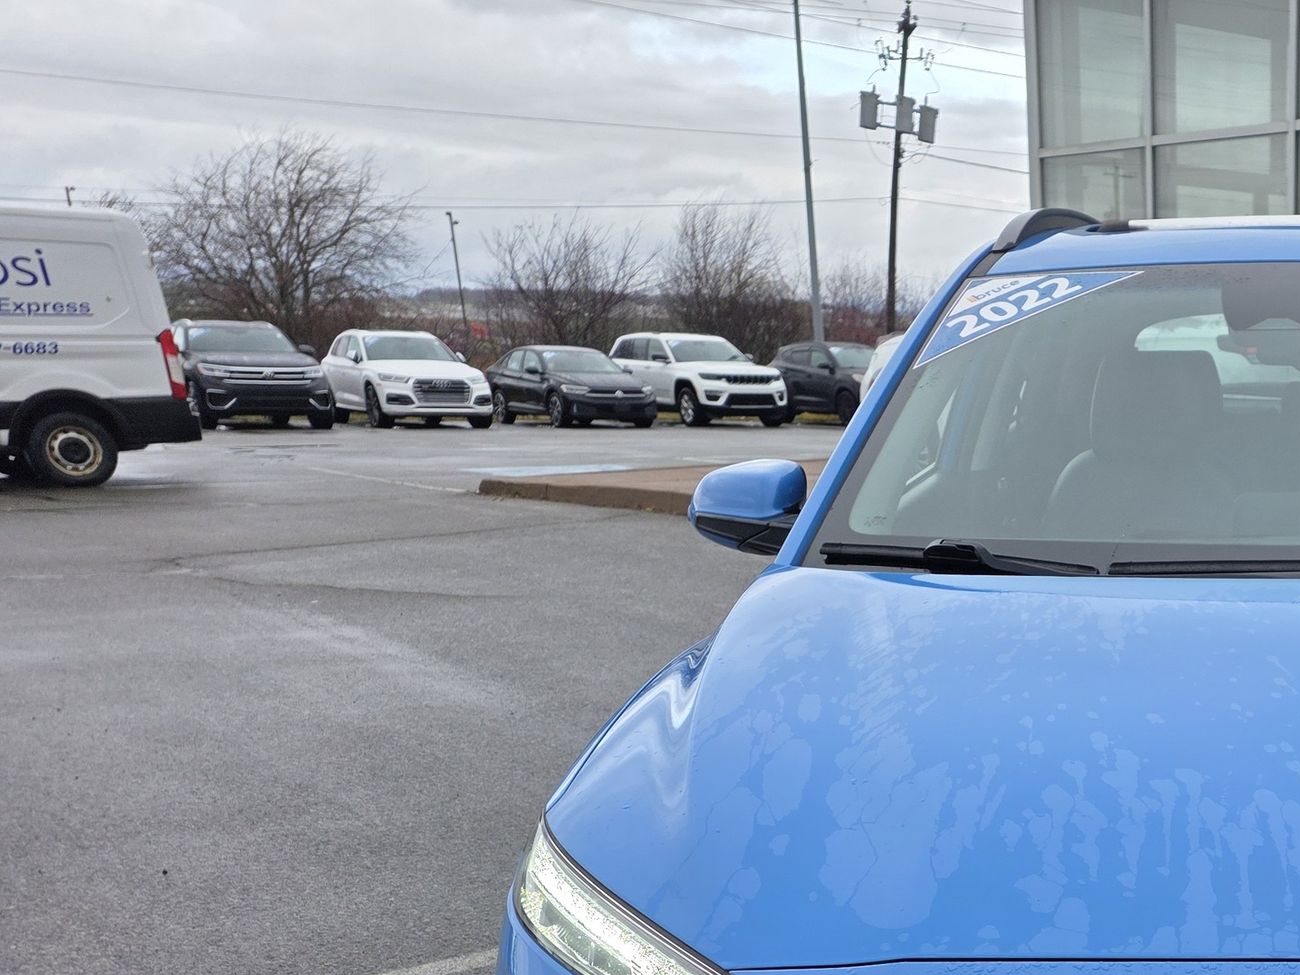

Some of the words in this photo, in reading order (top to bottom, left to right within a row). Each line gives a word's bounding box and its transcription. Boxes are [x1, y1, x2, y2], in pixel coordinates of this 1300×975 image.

[974, 279, 1020, 300] bruce
[0, 296, 91, 316] Express
[945, 277, 1082, 338] 2022
[0, 341, 59, 355] -6683
